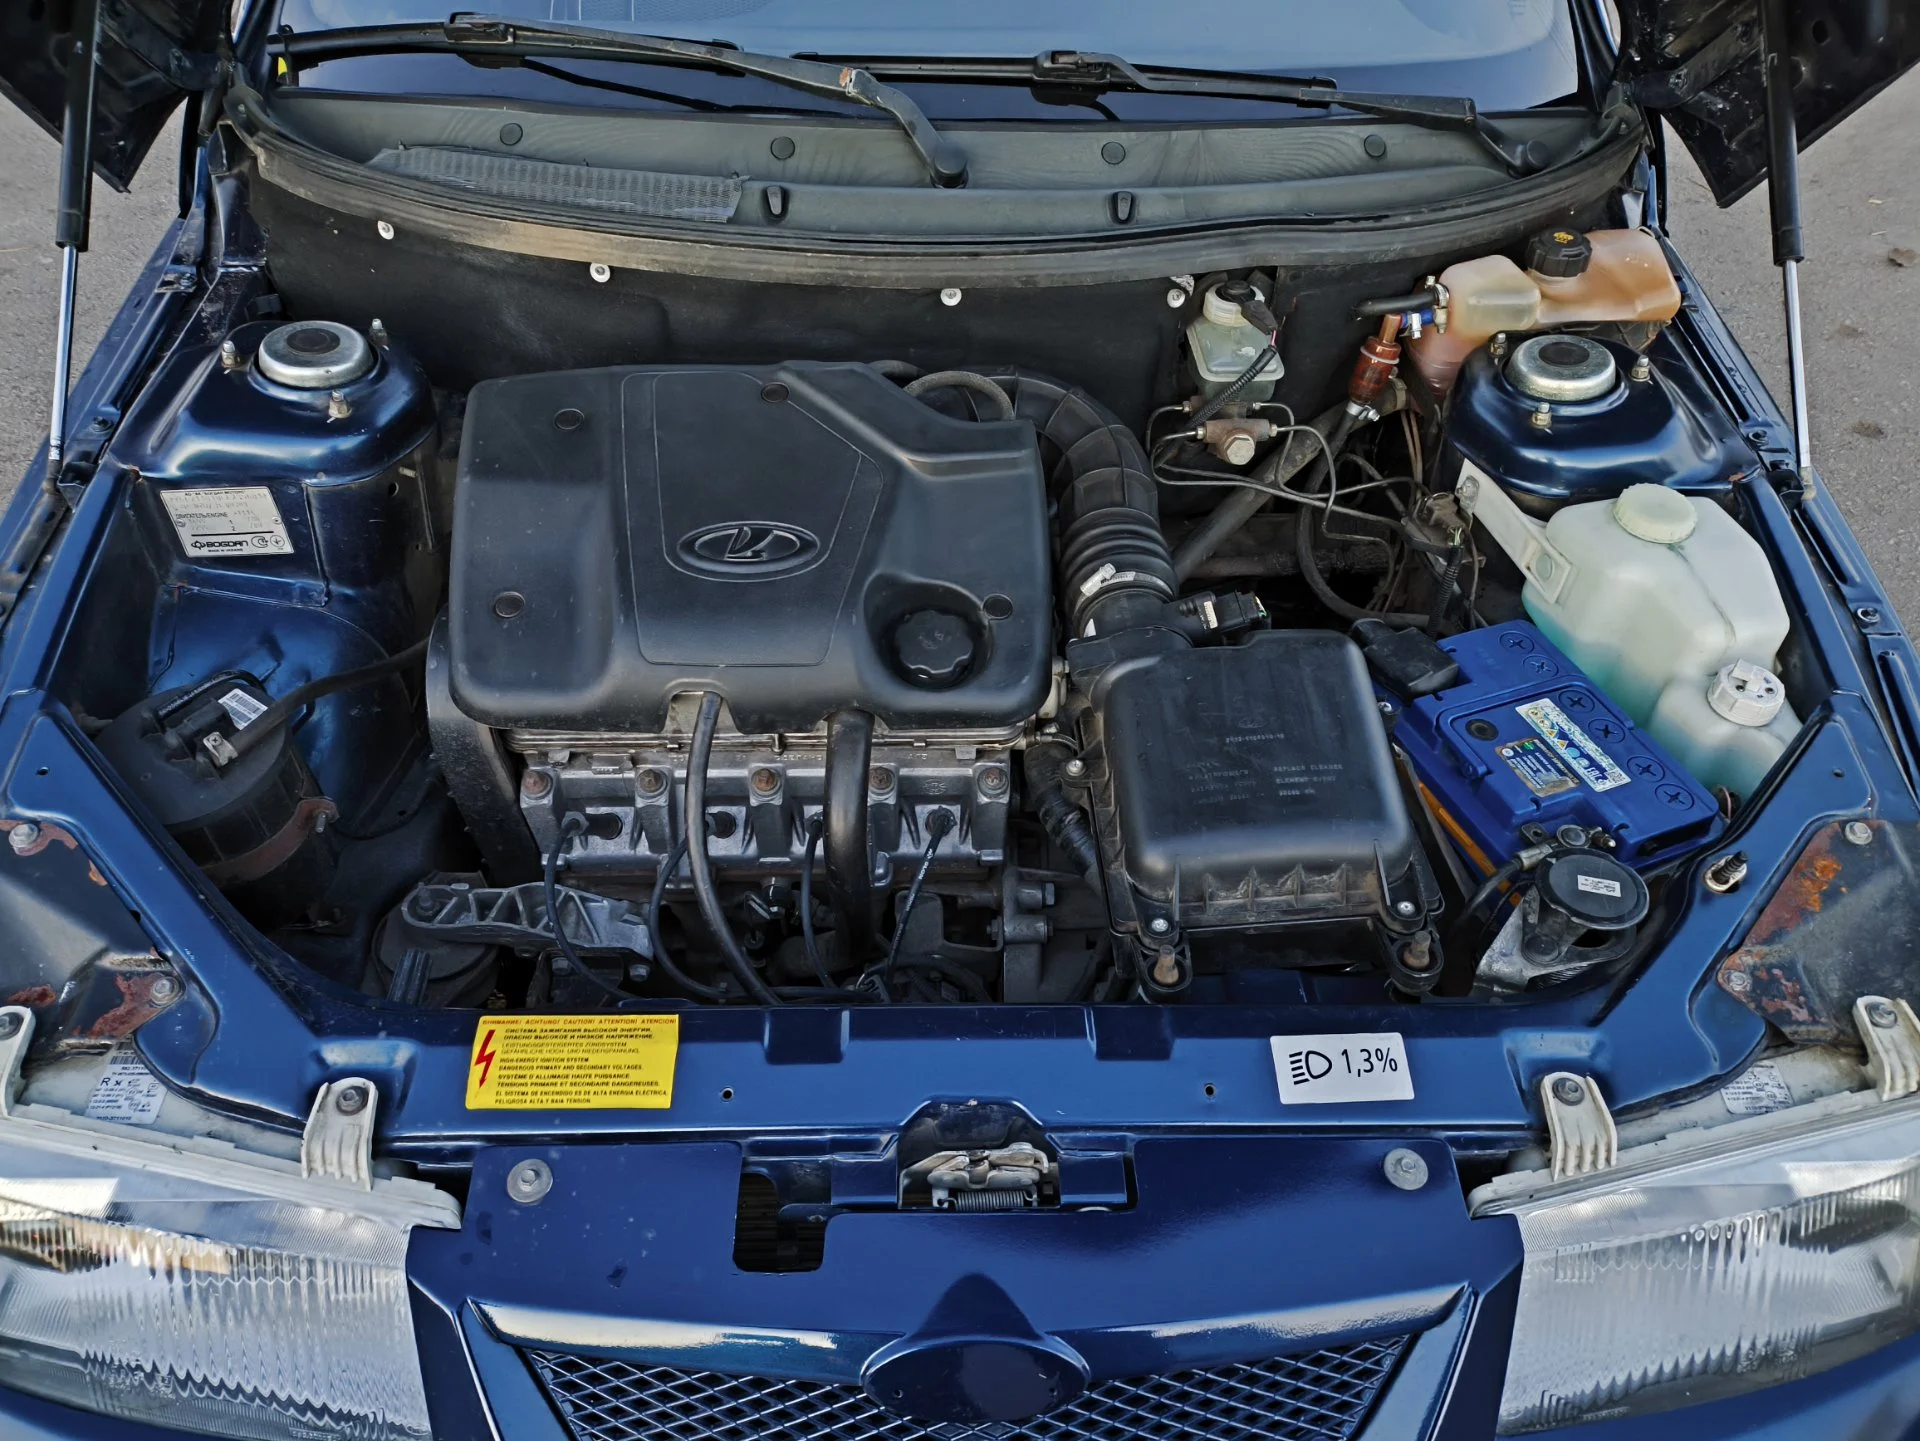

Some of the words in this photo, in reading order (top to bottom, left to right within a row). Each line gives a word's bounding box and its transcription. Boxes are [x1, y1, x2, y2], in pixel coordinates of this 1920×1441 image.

[205, 540, 249, 548] BOGDAN
[1341, 1047, 1398, 1077] 1,3%
[101, 1077, 111, 1086] R
